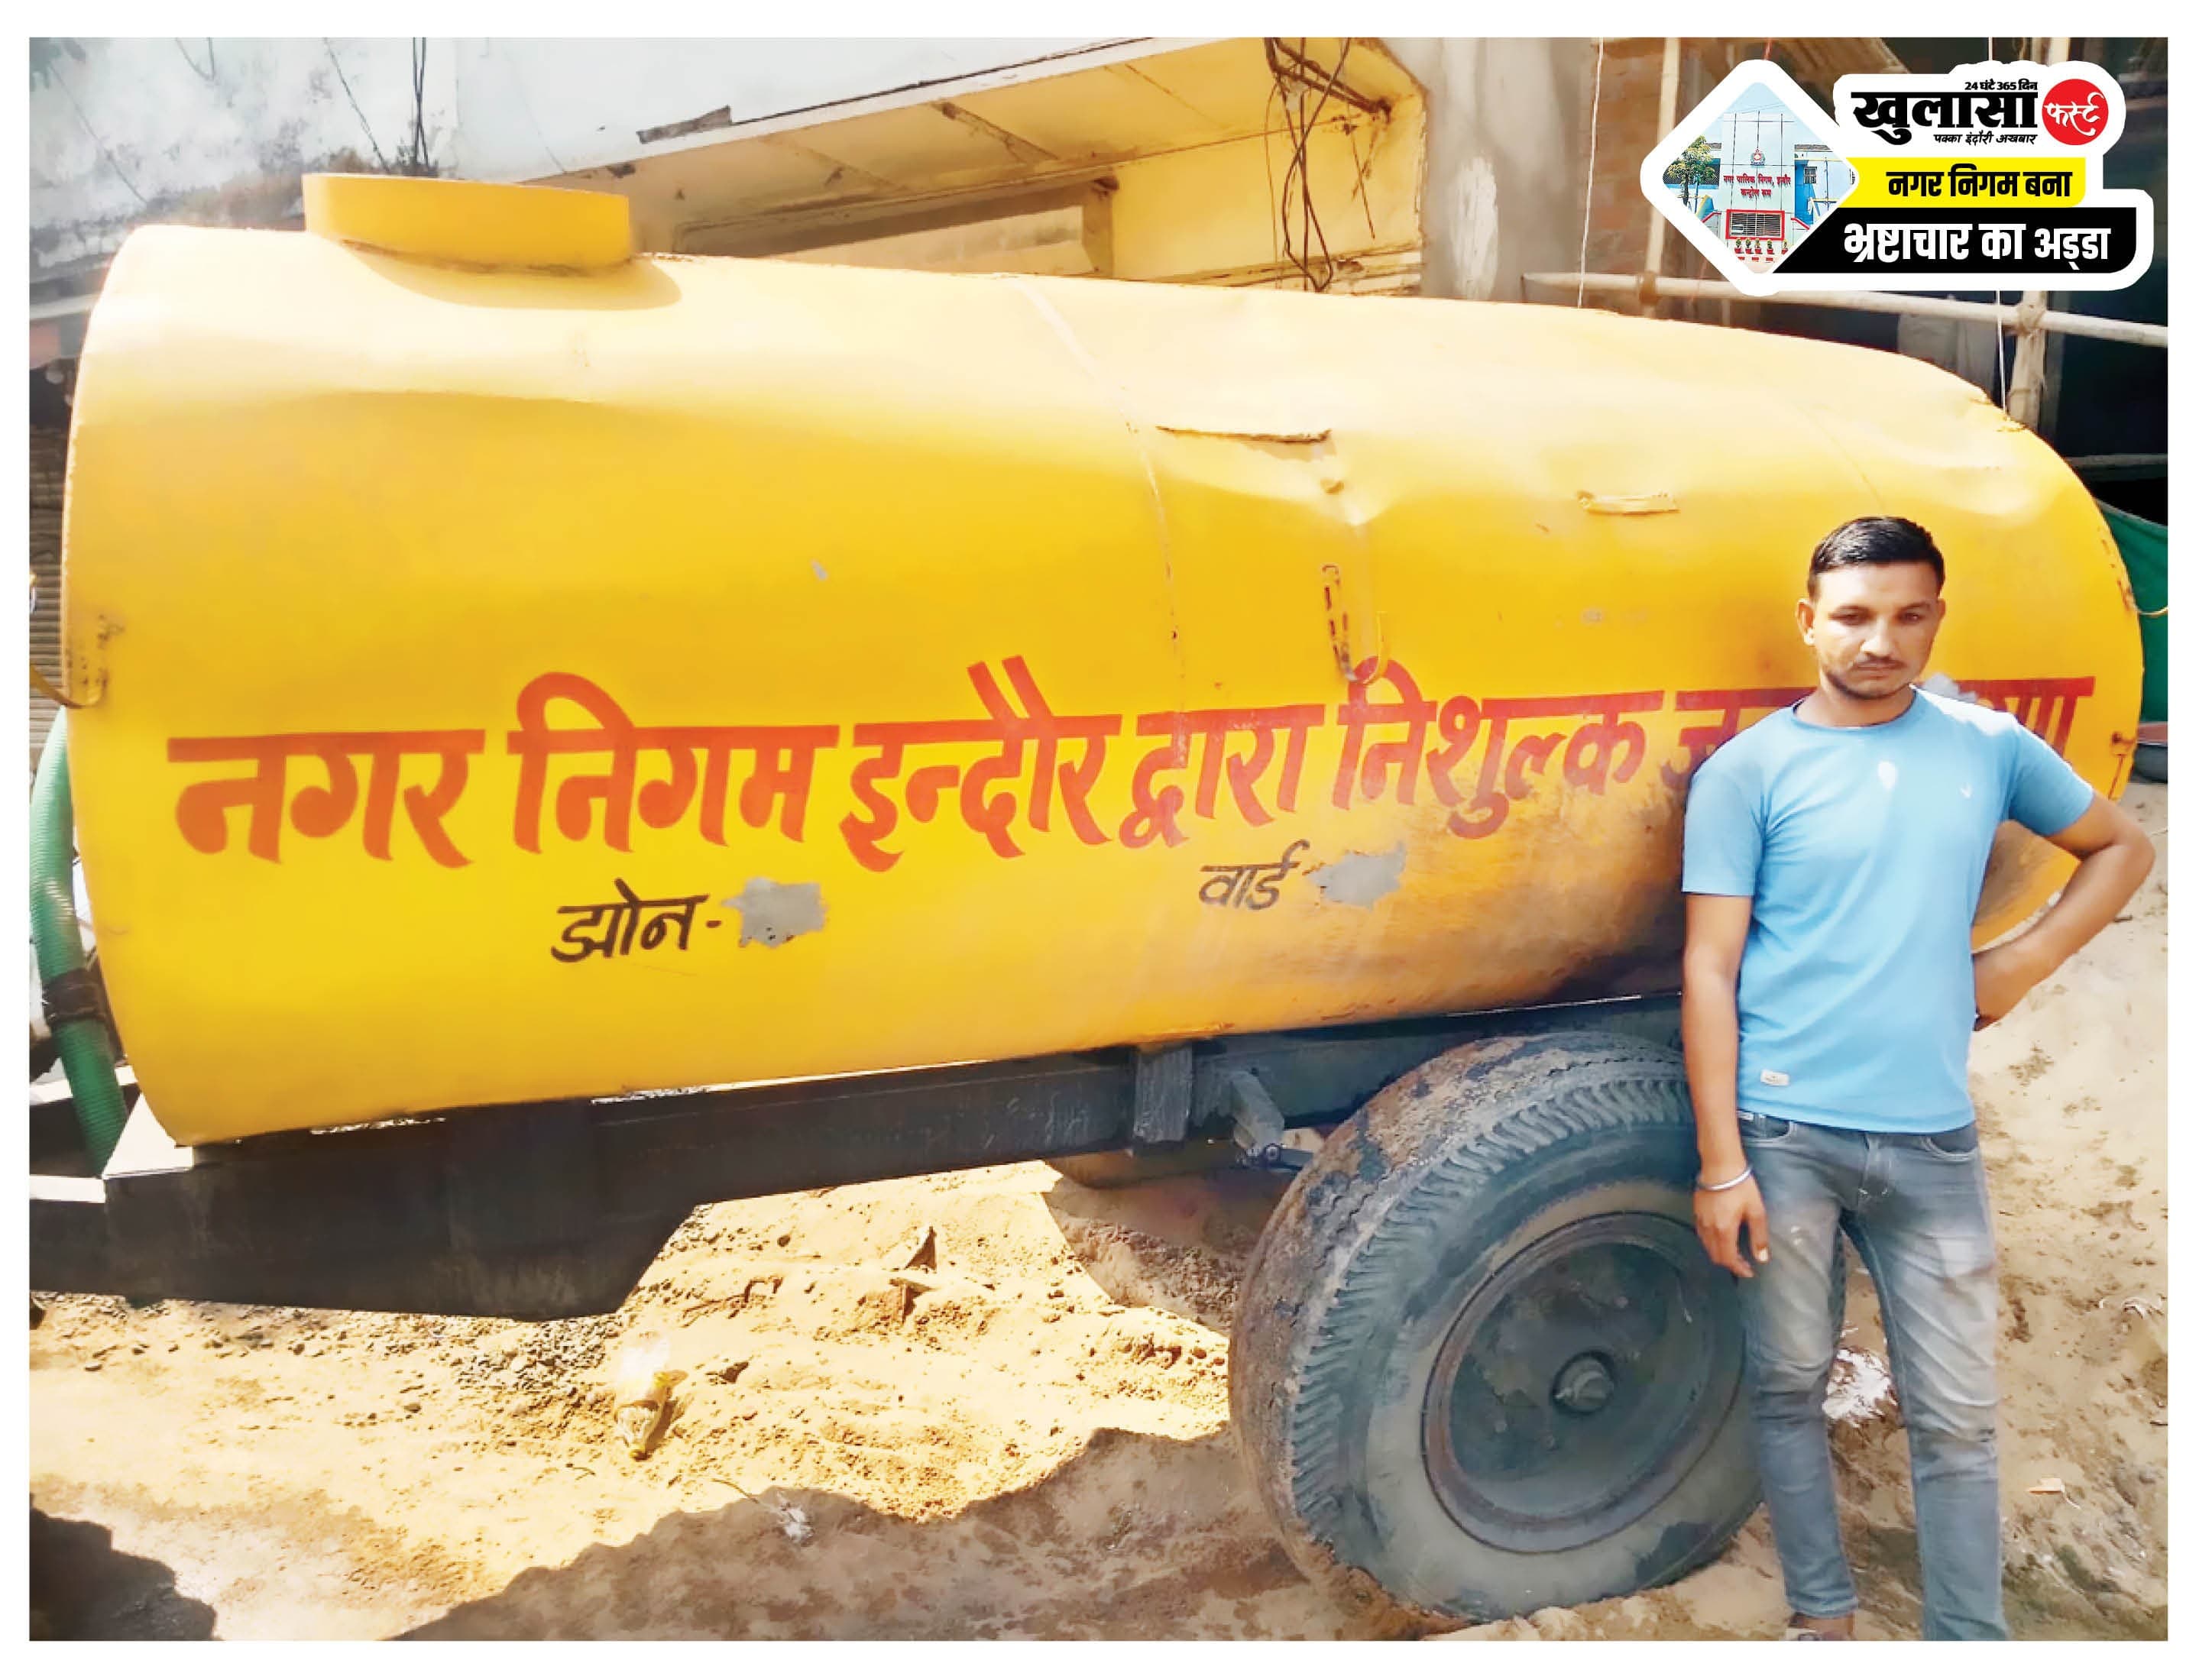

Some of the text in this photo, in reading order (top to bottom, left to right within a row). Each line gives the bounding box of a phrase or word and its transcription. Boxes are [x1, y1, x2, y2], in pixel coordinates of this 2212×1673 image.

[167, 729, 485, 868] नगर
[507, 671, 840, 854] निगम
[839, 655, 1122, 872] इन्दौर
[1119, 704, 1326, 849] द्वारा
[1332, 655, 1665, 839] निशुल्क
[1199, 839, 1310, 910] वार्ड
